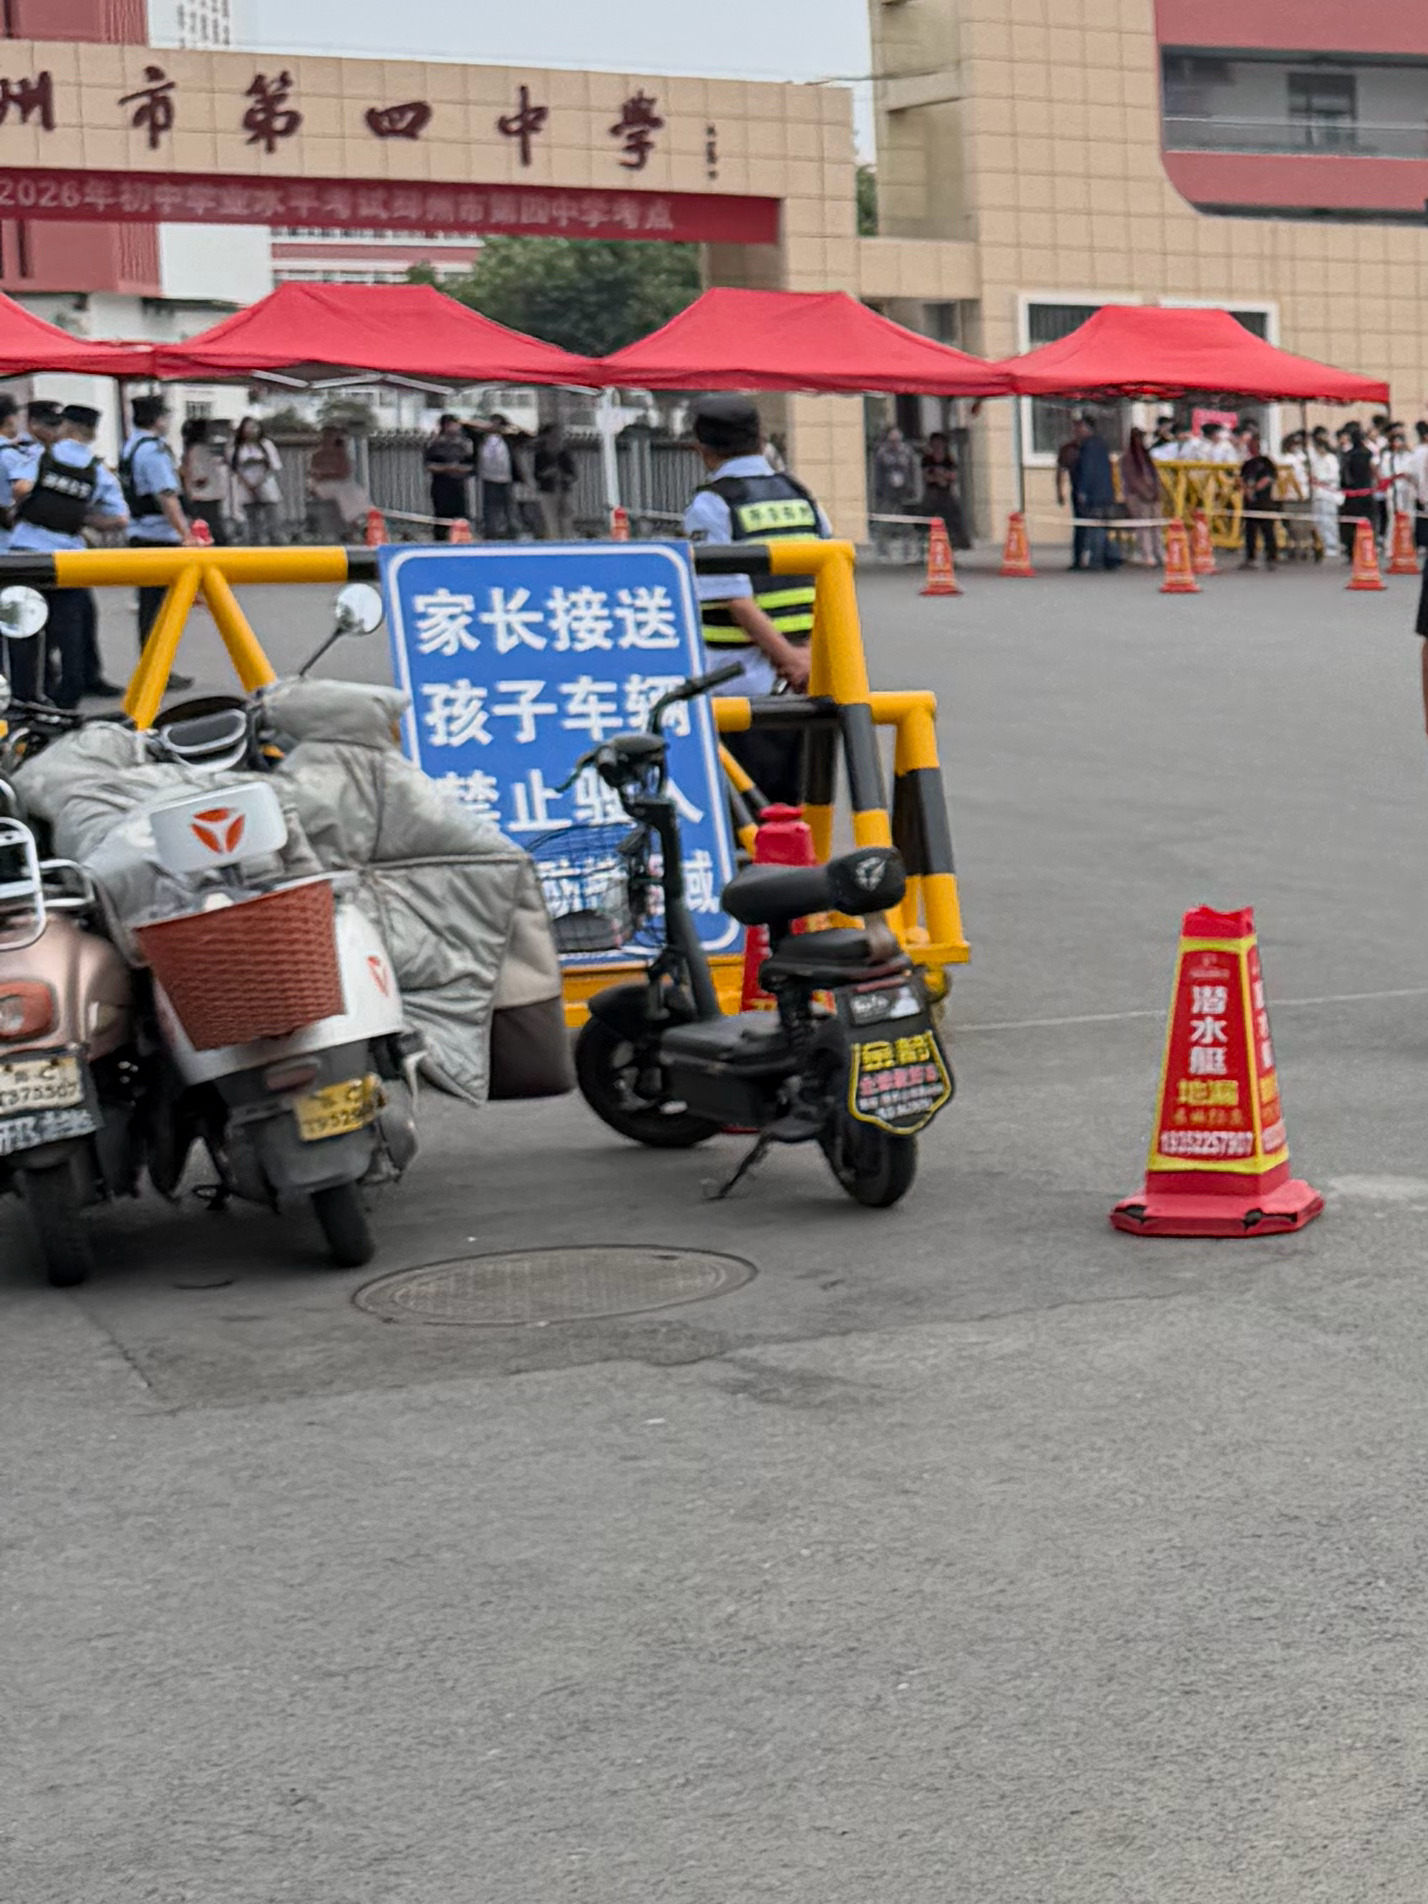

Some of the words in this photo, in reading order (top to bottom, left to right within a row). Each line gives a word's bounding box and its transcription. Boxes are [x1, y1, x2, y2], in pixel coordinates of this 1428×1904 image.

[413, 586, 680, 656] 家长接送
[420, 673, 693, 748] 孩子车辆
